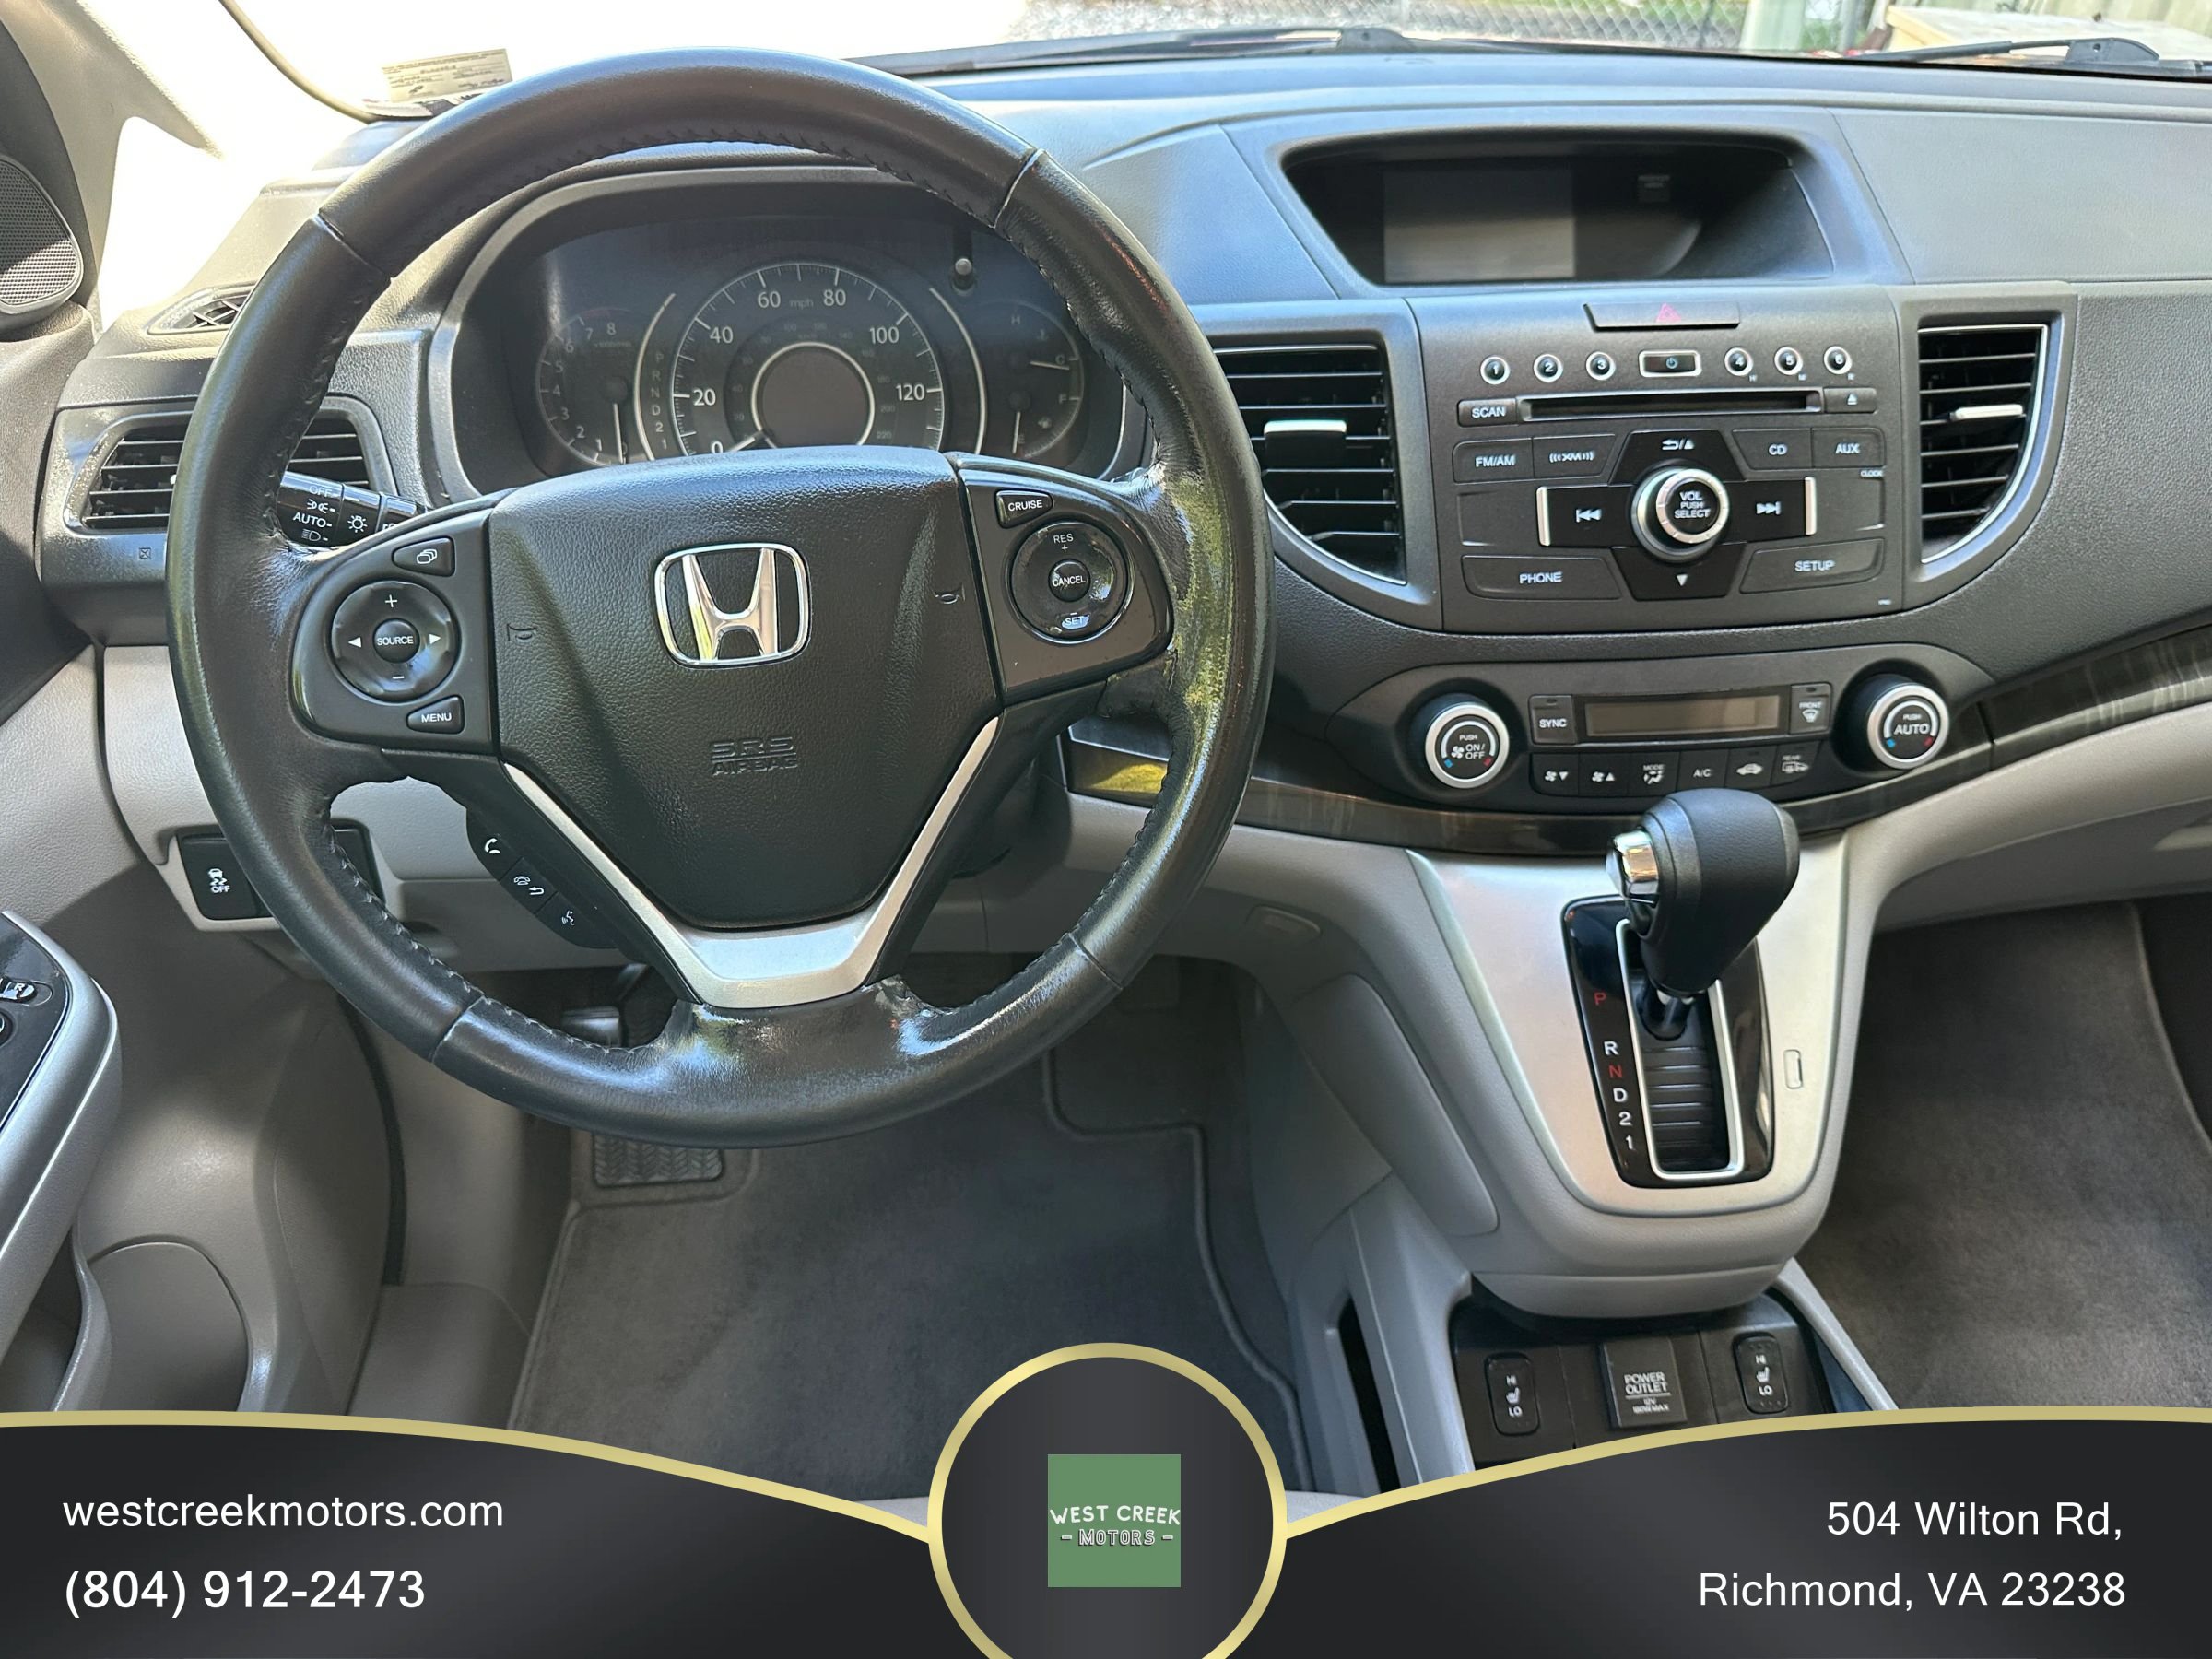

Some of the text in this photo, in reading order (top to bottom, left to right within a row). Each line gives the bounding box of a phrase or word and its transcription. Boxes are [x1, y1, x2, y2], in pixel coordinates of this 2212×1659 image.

[758, 290, 781, 308] 60
[823, 289, 846, 306] 80
[789, 298, 814, 310] mph
[585, 328, 594, 340] 7
[606, 323, 616, 335] 8
[710, 326, 734, 344] 40
[869, 326, 900, 344] 100
[565, 342, 574, 353] 6
[1492, 354, 1843, 375] 1 2 3 4 5 6
[553, 385, 561, 397] 4
[651, 387, 660, 398] N
[896, 383, 925, 402] 120
[693, 389, 716, 406] 20
[561, 407, 570, 420] 3
[652, 406, 660, 415] D
[1472, 406, 1506, 419] SCAN
[577, 426, 585, 439] 2
[655, 422, 664, 432] 2
[596, 439, 603, 451] 1
[1768, 443, 1788, 455] CD
[1835, 443, 1860, 454] AUX
[1475, 454, 1516, 467] FM/AM
[309, 485, 332, 498] OFF
[1679, 490, 1703, 501] VOL
[1007, 500, 1043, 512] CRUISE
[1680, 501, 1704, 510] PUSH
[293, 512, 326, 528] AUTO
[1674, 509, 1711, 519] SELECT
[1053, 533, 1074, 544] RES
[1794, 559, 1836, 571] SETUP
[1052, 575, 1086, 587] CANCEL
[1519, 571, 1563, 584] PHONE
[1065, 616, 1084, 625] SET
[377, 636, 414, 646] SOURCE
[421, 712, 452, 724] MENU
[1539, 718, 1567, 728] SYNC
[1893, 723, 1930, 735] AUTO
[1465, 744, 1486, 752] ON/
[1465, 751, 1485, 759] OFF
[1693, 768, 1712, 778] A/C
[211, 885, 230, 894] OFF
[1594, 992, 1606, 1006] P
[1604, 1041, 1619, 1056] R
[1608, 1064, 1623, 1078] N
[1613, 1088, 1628, 1103] D
[1618, 1112, 1632, 1126] 2
[1625, 1135, 1636, 1151] 1
[1624, 1371, 1665, 1383] POWER
[1625, 1381, 1668, 1394] OUTLET
[1759, 1384, 1773, 1396] LO
[1508, 1406, 1523, 1418] LO
